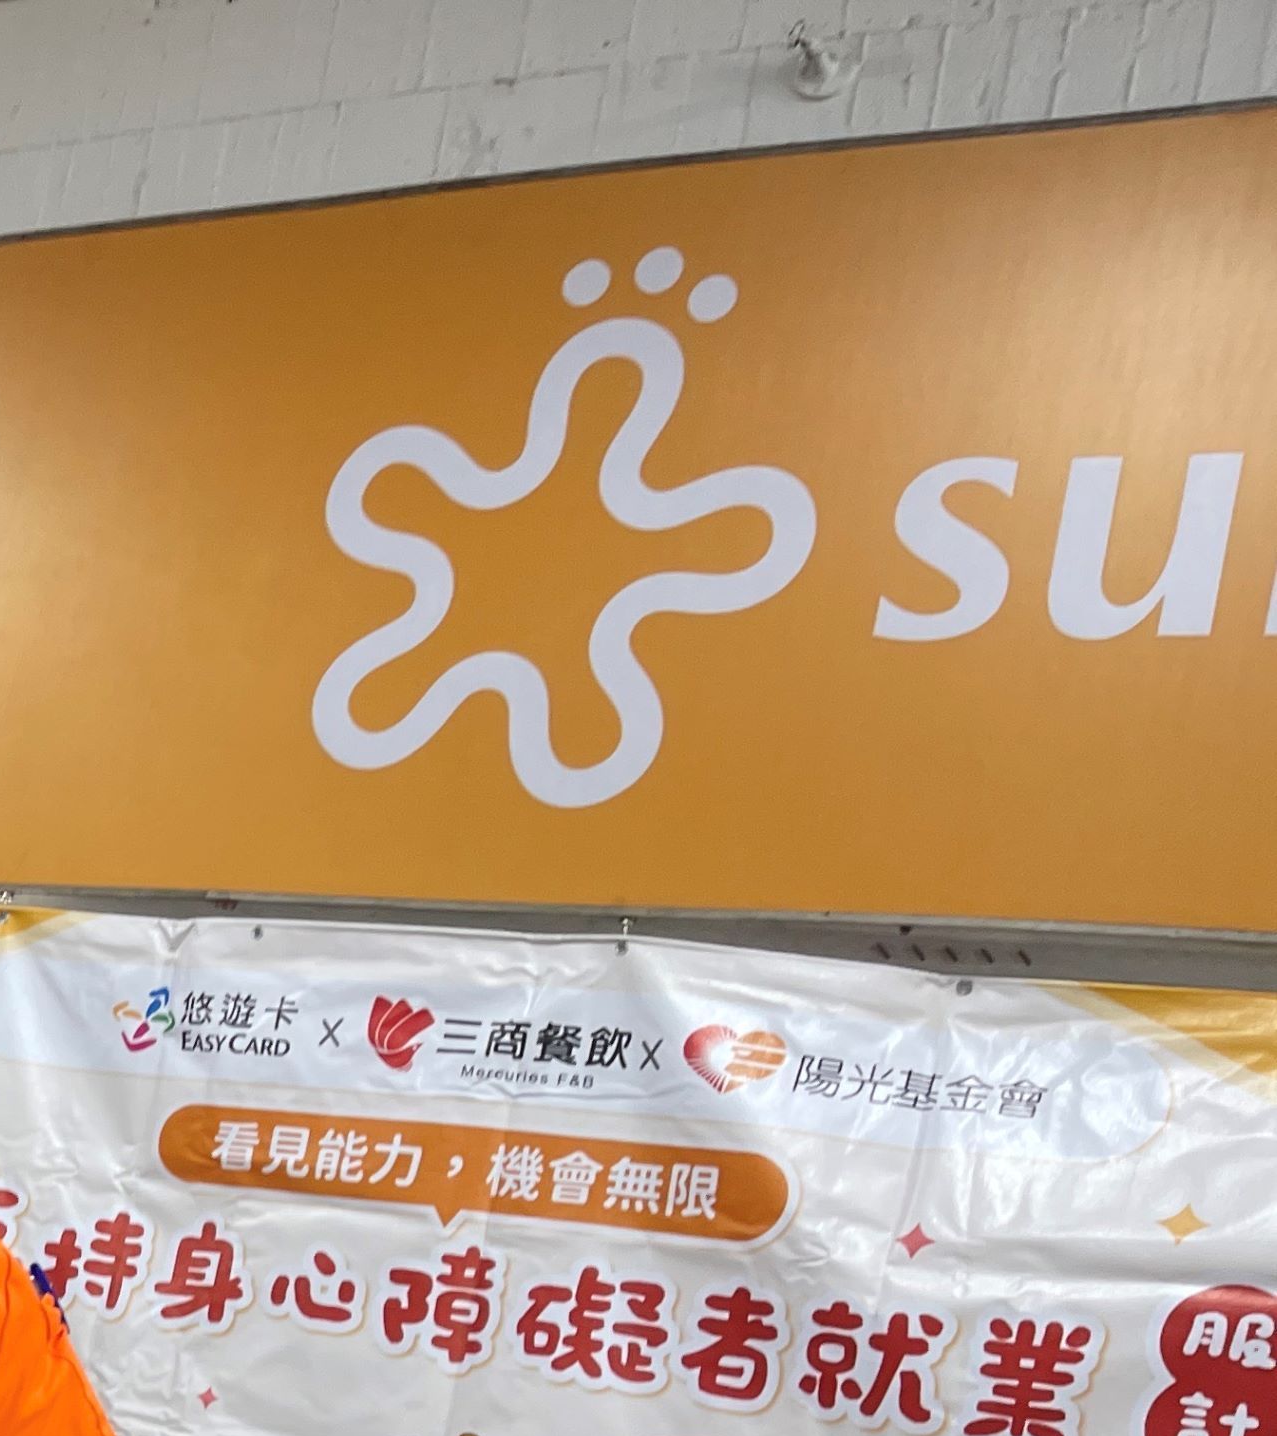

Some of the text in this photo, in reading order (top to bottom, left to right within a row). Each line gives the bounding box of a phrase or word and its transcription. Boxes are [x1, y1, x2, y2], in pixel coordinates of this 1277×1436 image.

[872, 452, 1277, 642] su
[181, 989, 299, 1028] 悠遊卡
[436, 1017, 633, 1069] 三商餐飲
[460, 1064, 549, 1087] Mercuries
[792, 1054, 1049, 1119] 陽光基金會
